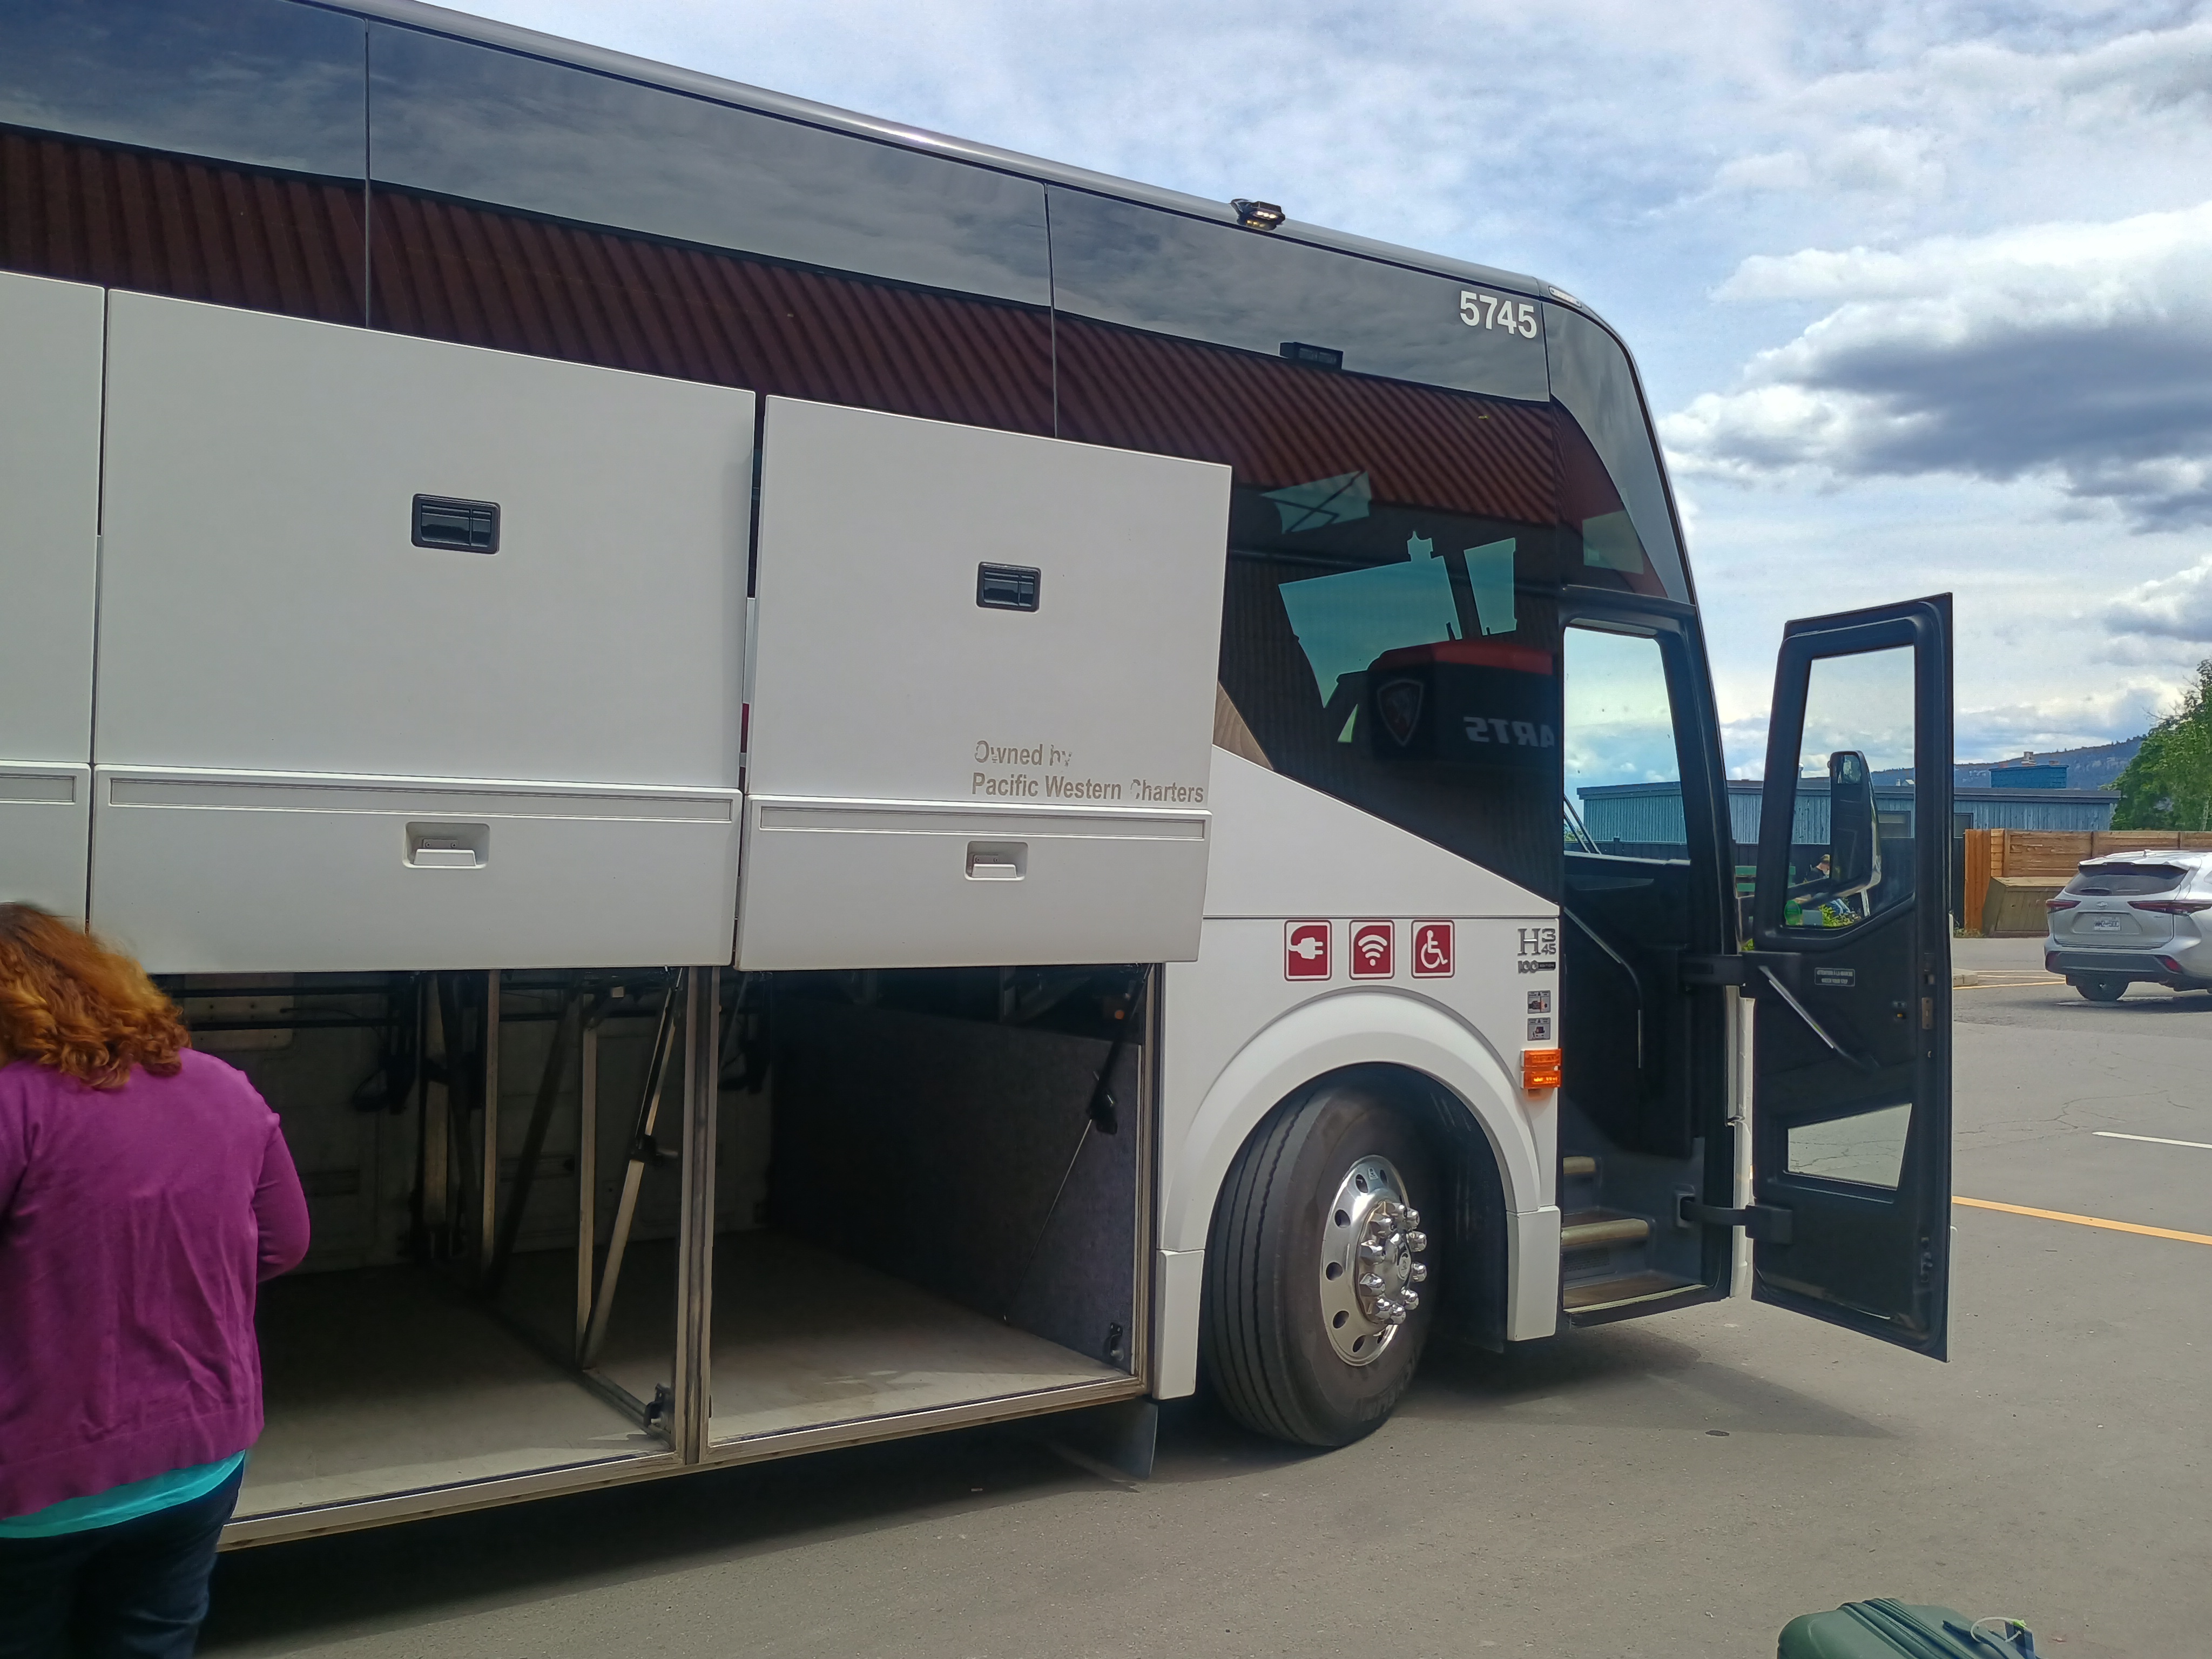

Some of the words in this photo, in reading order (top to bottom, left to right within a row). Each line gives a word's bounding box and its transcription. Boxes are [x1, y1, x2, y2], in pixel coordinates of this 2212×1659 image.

[1460, 290, 1537, 339] 5745
[974, 740, 1043, 766] Owned
[972, 772, 1039, 797] Pacific
[1045, 775, 1121, 800] Western
[1518, 960, 1538, 973] 100
